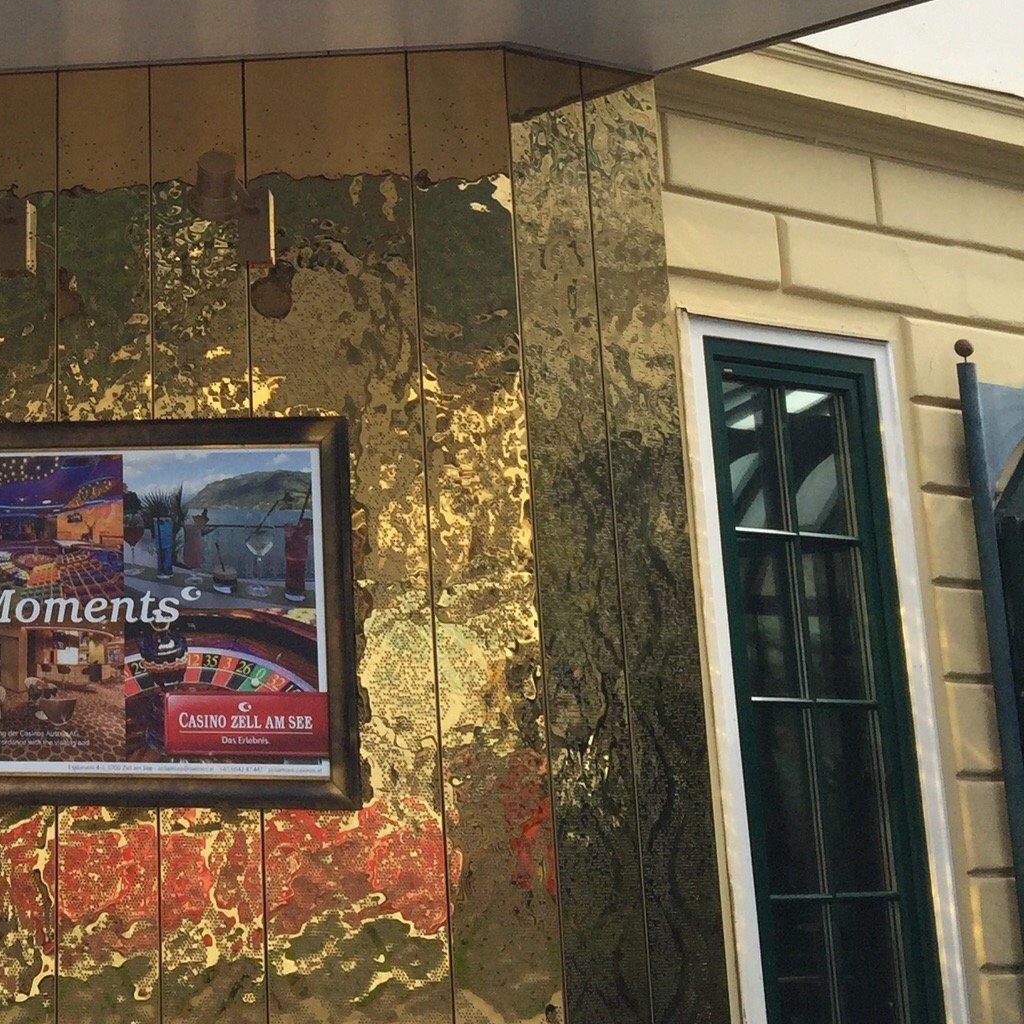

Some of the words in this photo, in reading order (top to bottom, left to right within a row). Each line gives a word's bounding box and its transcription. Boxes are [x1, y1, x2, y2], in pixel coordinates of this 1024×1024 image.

[203, 654, 218, 668] 35
[238, 661, 252, 675] 26
[178, 712, 227, 728] CASINO
[230, 715, 262, 729] ZELL
[265, 715, 285, 729] AM
[288, 716, 313, 730] SEE
[221, 736, 236, 744] Das
